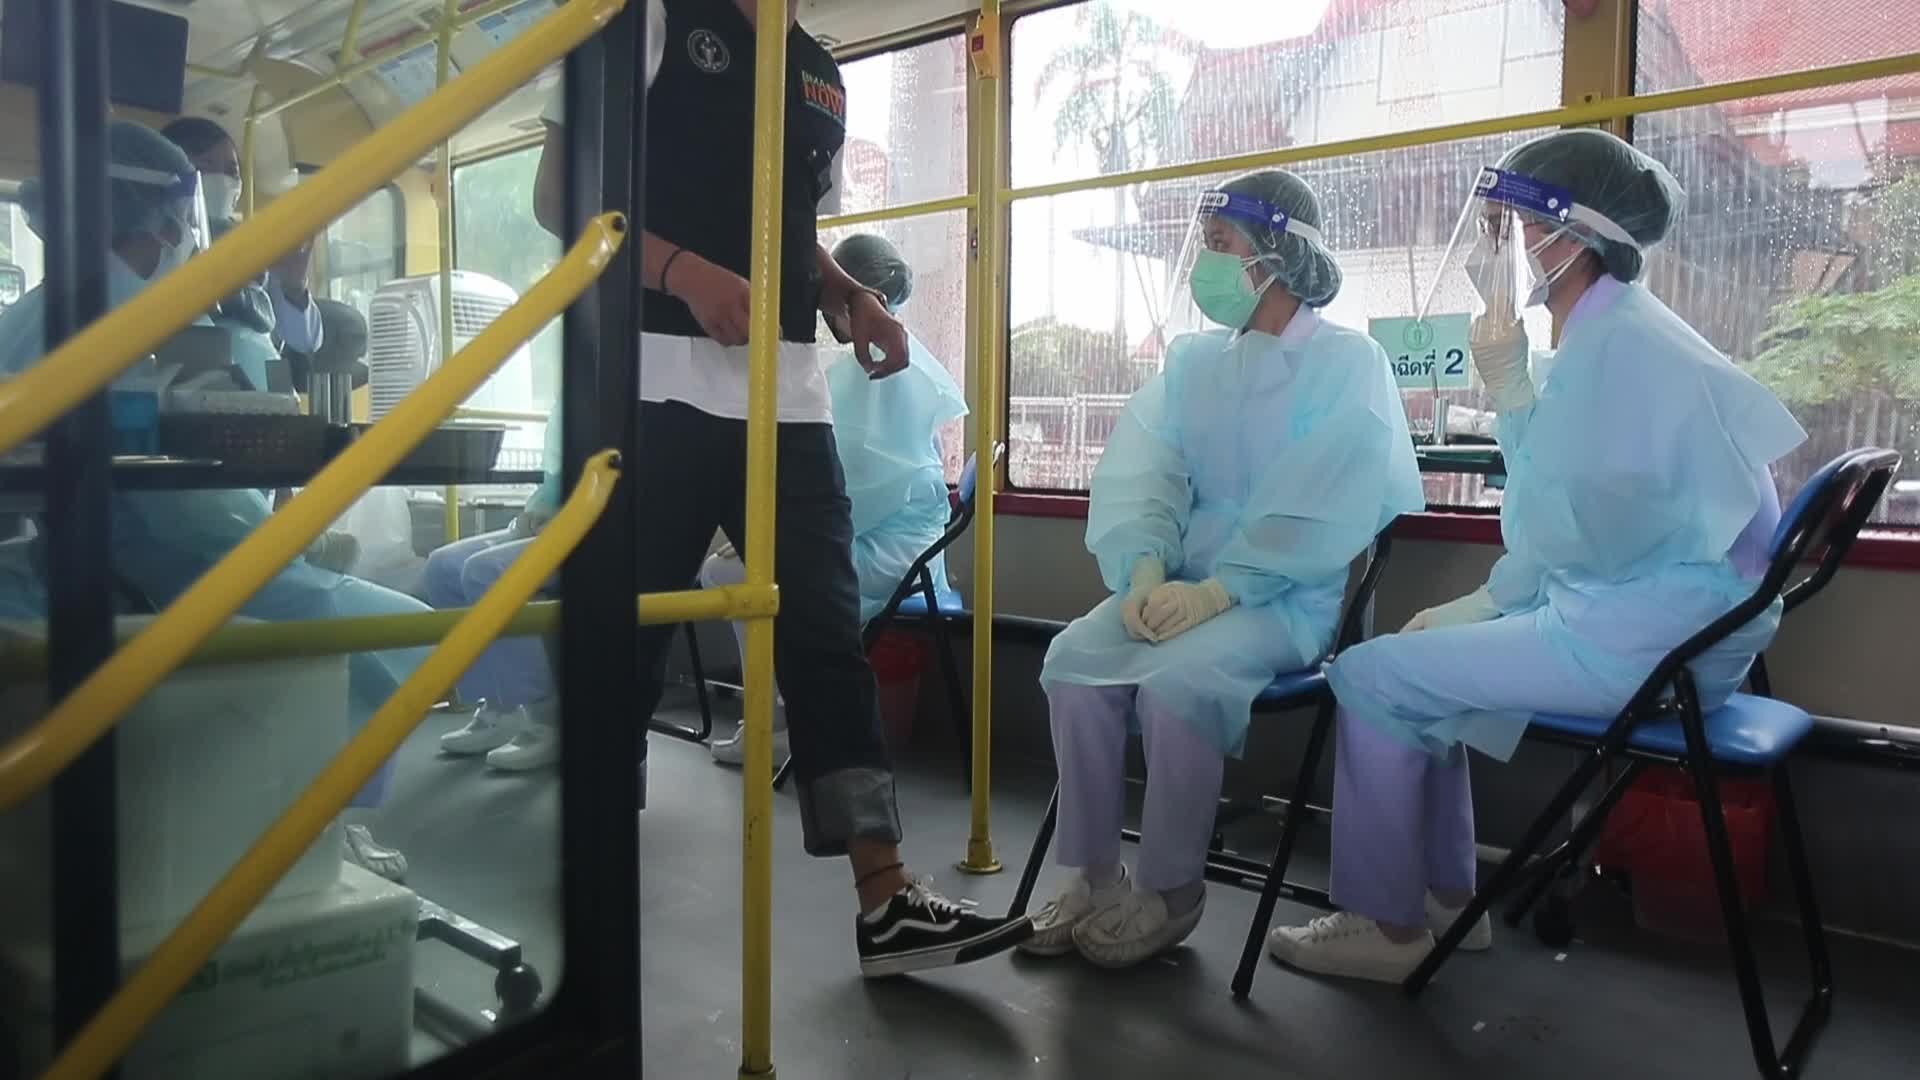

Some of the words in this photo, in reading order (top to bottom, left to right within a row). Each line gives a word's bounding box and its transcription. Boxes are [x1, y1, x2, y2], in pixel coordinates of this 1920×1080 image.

[1391, 349, 1436, 376] ฉีดที่
[1445, 348, 1464, 375] 2
